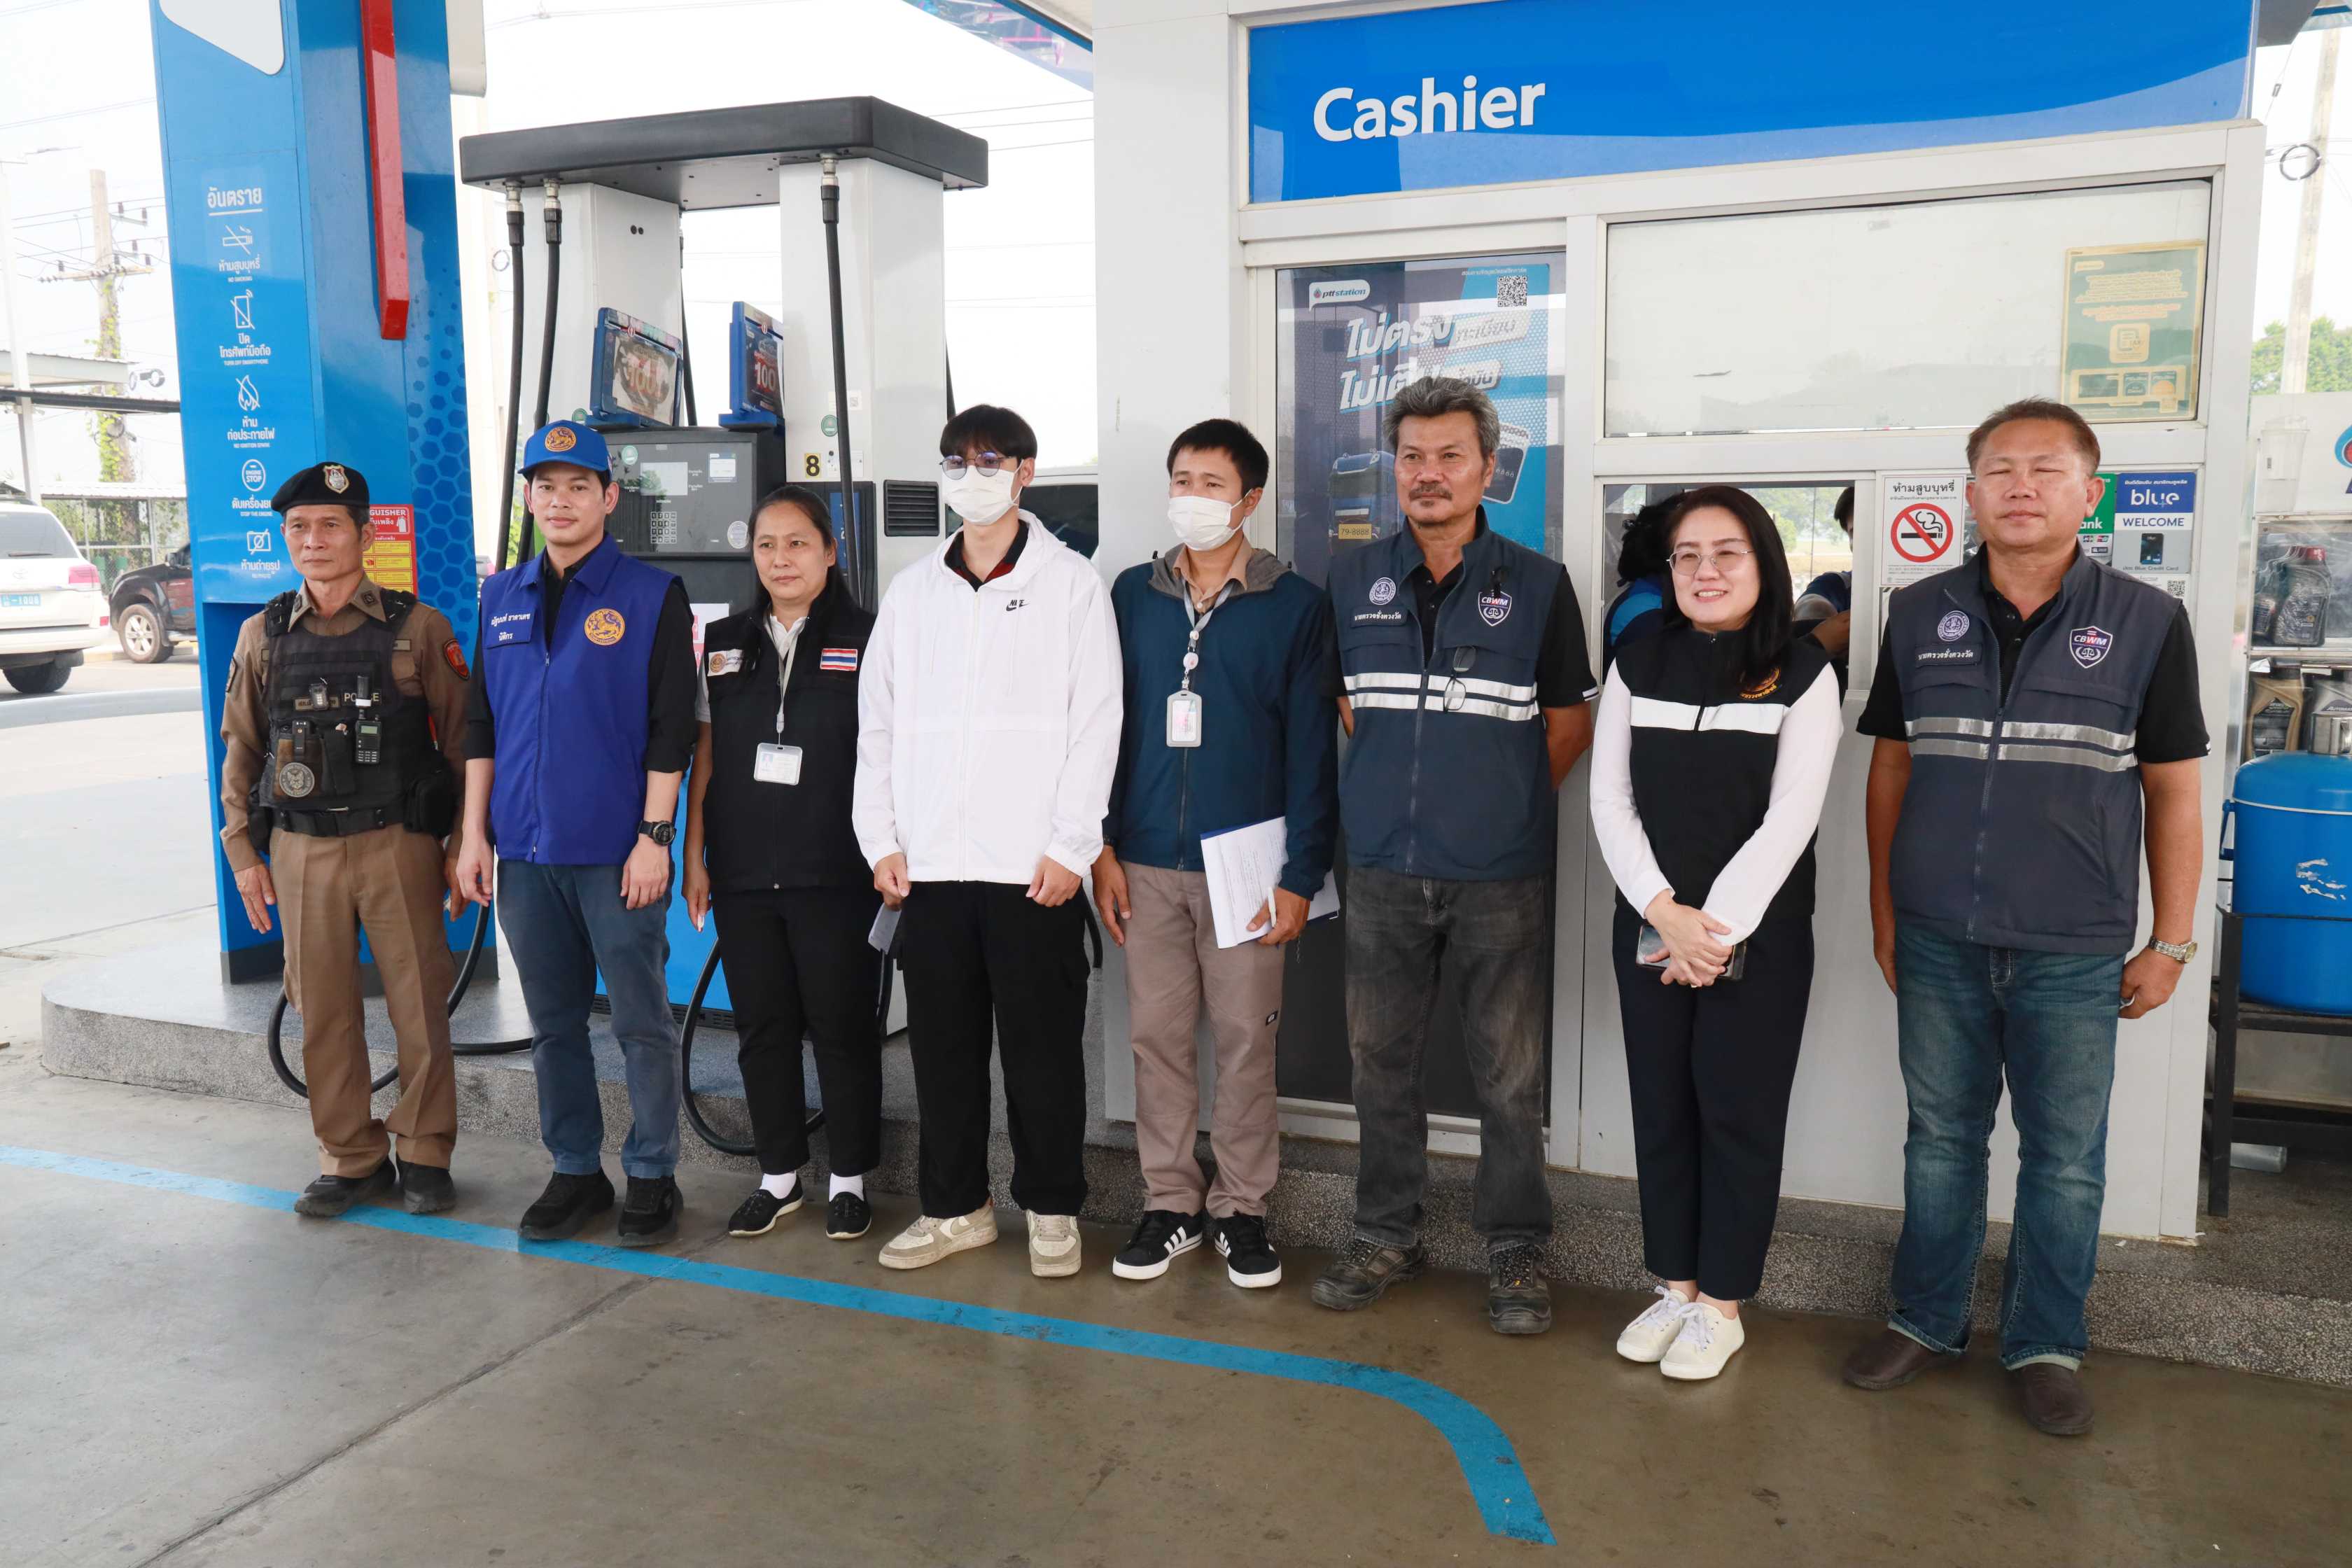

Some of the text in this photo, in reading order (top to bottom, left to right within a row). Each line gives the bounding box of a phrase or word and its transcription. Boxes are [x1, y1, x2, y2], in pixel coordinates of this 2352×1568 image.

[1313, 75, 1546, 142] Cashier
[207, 186, 262, 208] อันตราย
[218, 254, 260, 274] ห้ามสูบบุหรี่
[238, 332, 251, 344] ปิด
[1346, 313, 1453, 360] ไม่ตรง
[219, 344, 272, 358] โทรศัพท์มือถือ
[755, 361, 776, 391] 100
[242, 416, 258, 427] ห้าม
[227, 428, 275, 440] ก่อประกายไฟ
[806, 455, 820, 477] 8
[1893, 479, 1954, 496] ห้ามสูบบุหรี่
[2122, 518, 2185, 526] WELCOME
[241, 559, 280, 574] ห้ามถ่ายรูป
[1481, 597, 1508, 606] CBWM
[2074, 636, 2107, 645] CBWM
